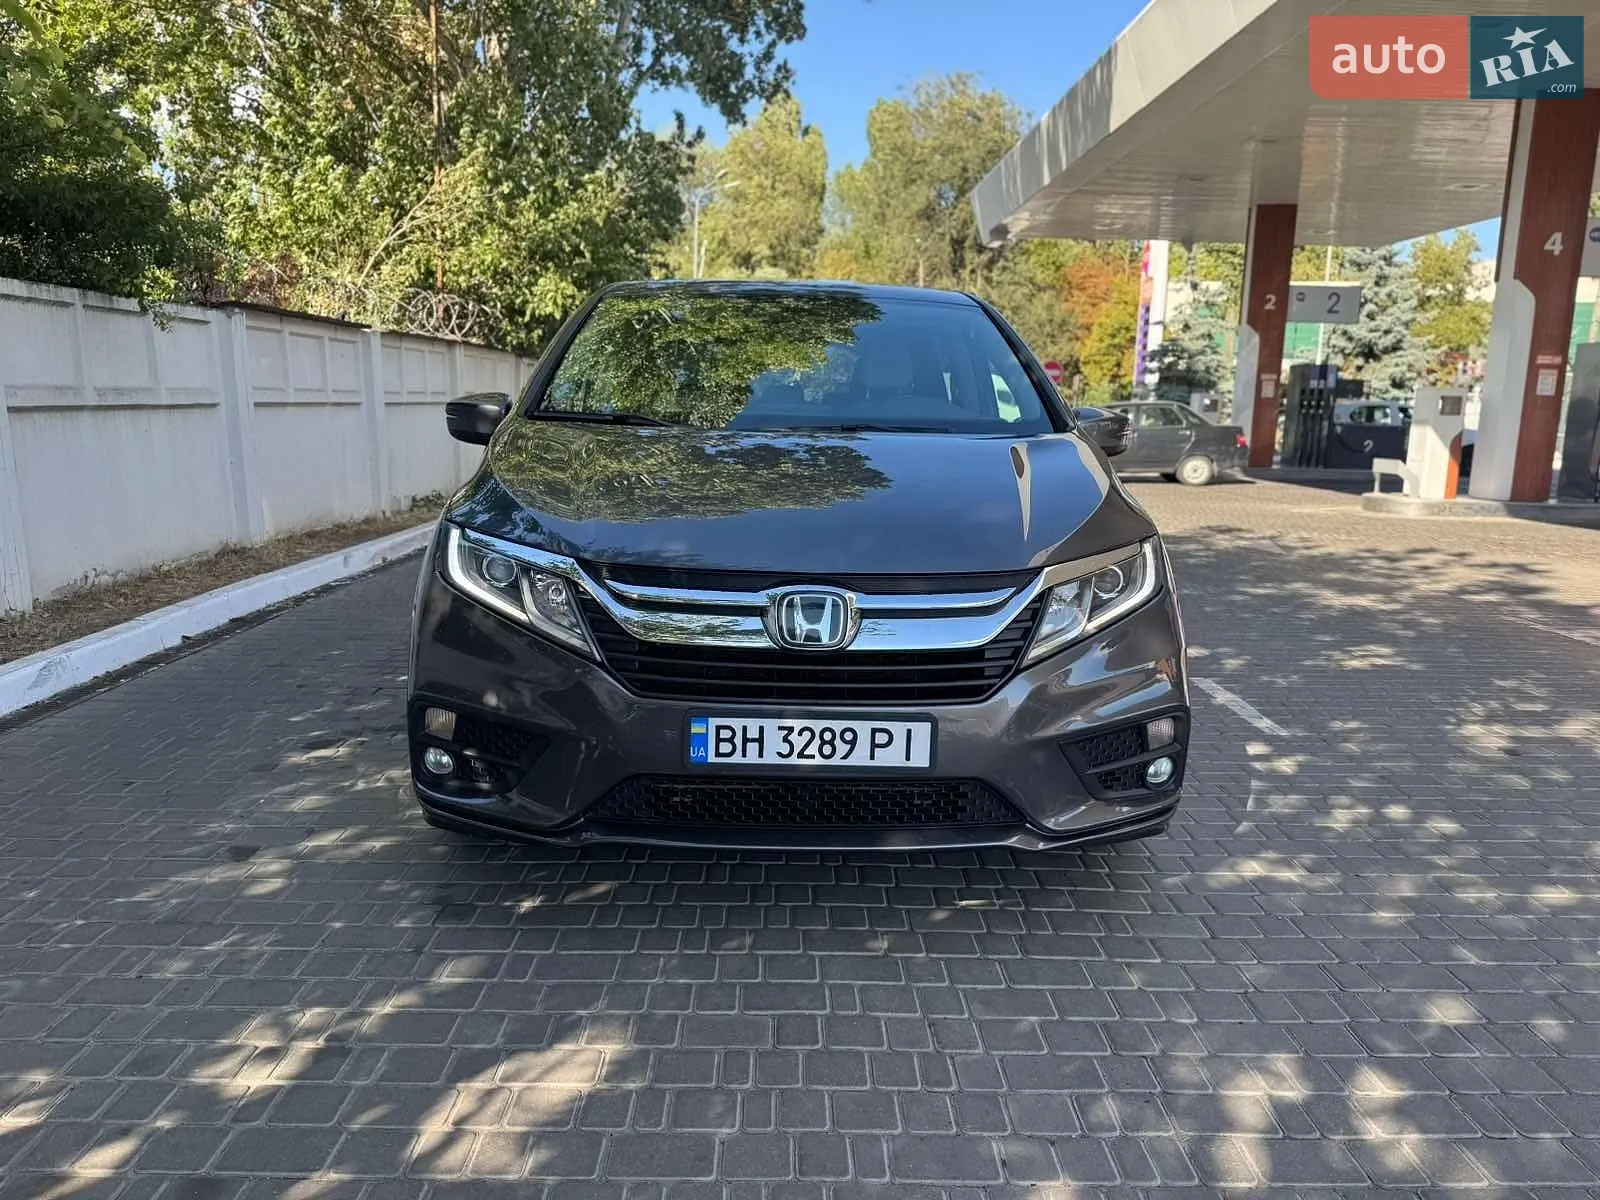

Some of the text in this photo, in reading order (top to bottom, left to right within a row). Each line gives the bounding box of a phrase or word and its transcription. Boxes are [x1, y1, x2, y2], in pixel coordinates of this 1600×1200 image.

[1543, 231, 1564, 257] 4
[1263, 293, 1277, 310] 2
[1327, 292, 1341, 315] 2
[690, 745, 706, 758] UA
[713, 724, 765, 759] BH
[776, 725, 859, 760] 3289
